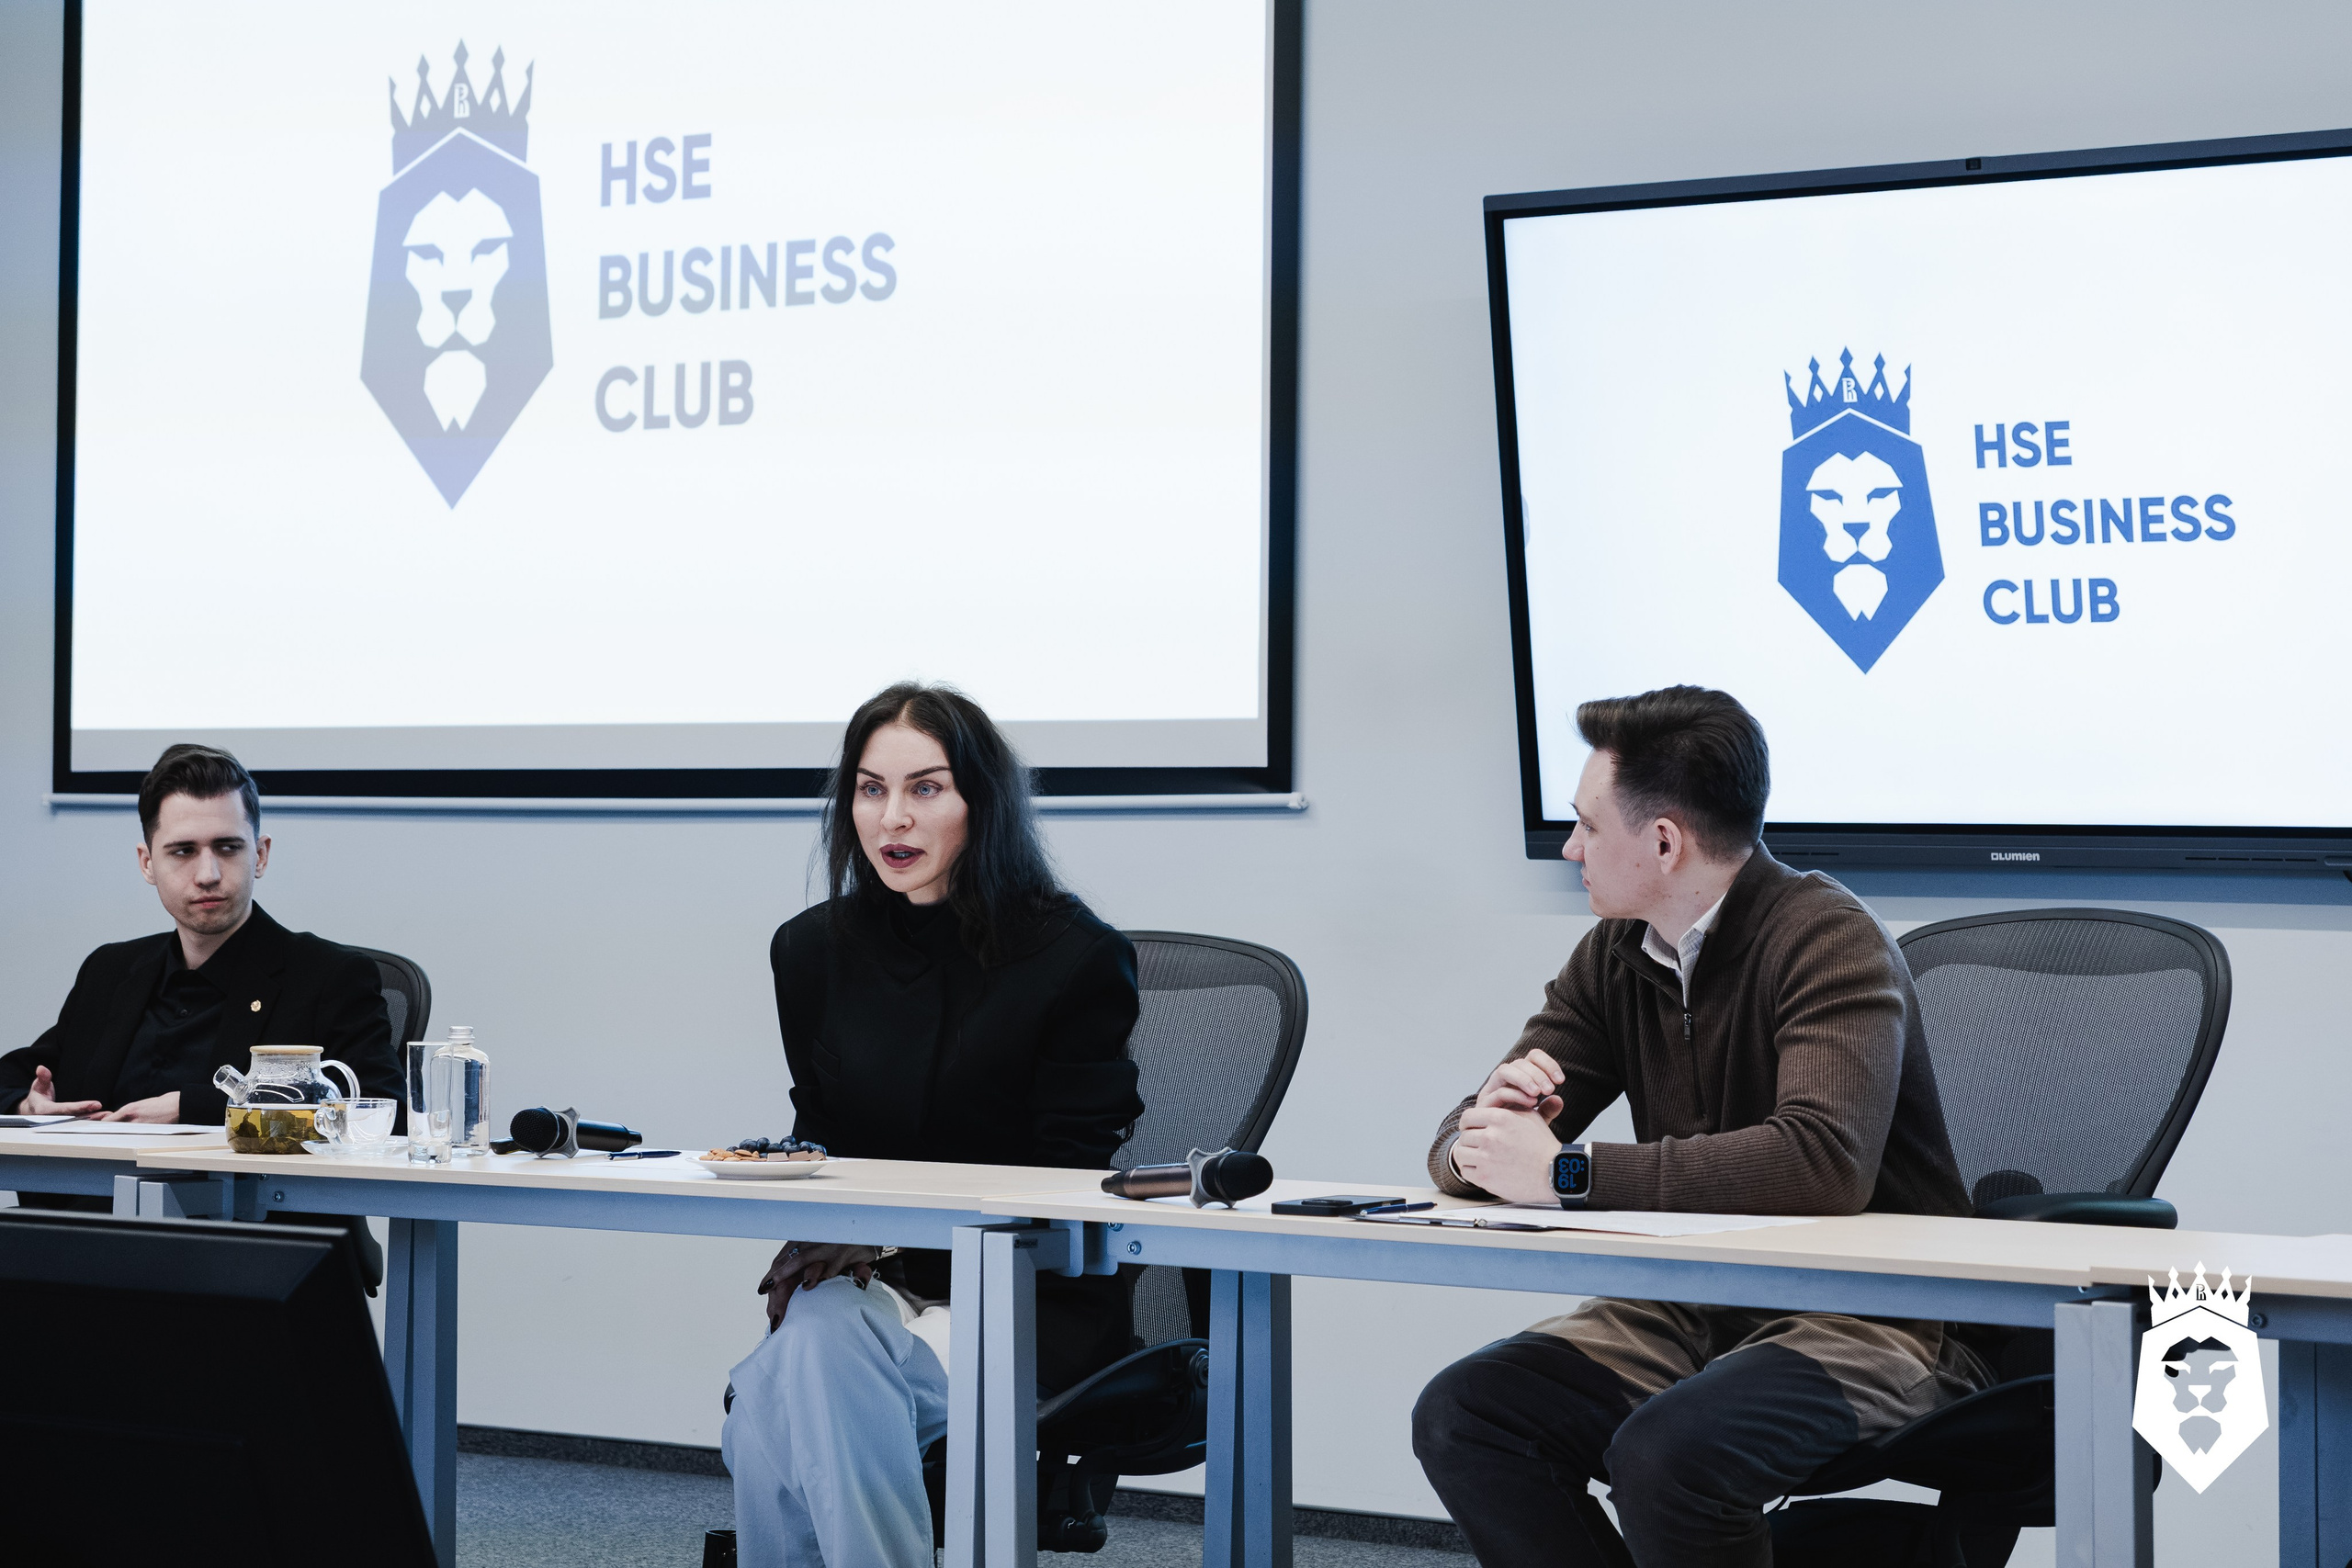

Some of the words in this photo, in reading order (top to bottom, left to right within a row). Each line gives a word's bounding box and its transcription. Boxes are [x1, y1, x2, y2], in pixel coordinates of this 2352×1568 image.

[599, 132, 712, 208] HSE
[597, 231, 898, 321] BUSINESS
[594, 359, 754, 434] CLUB
[1974, 420, 2073, 468] HSE
[1979, 494, 2237, 547] BUSINESS
[1983, 578, 2120, 626] CLUB
